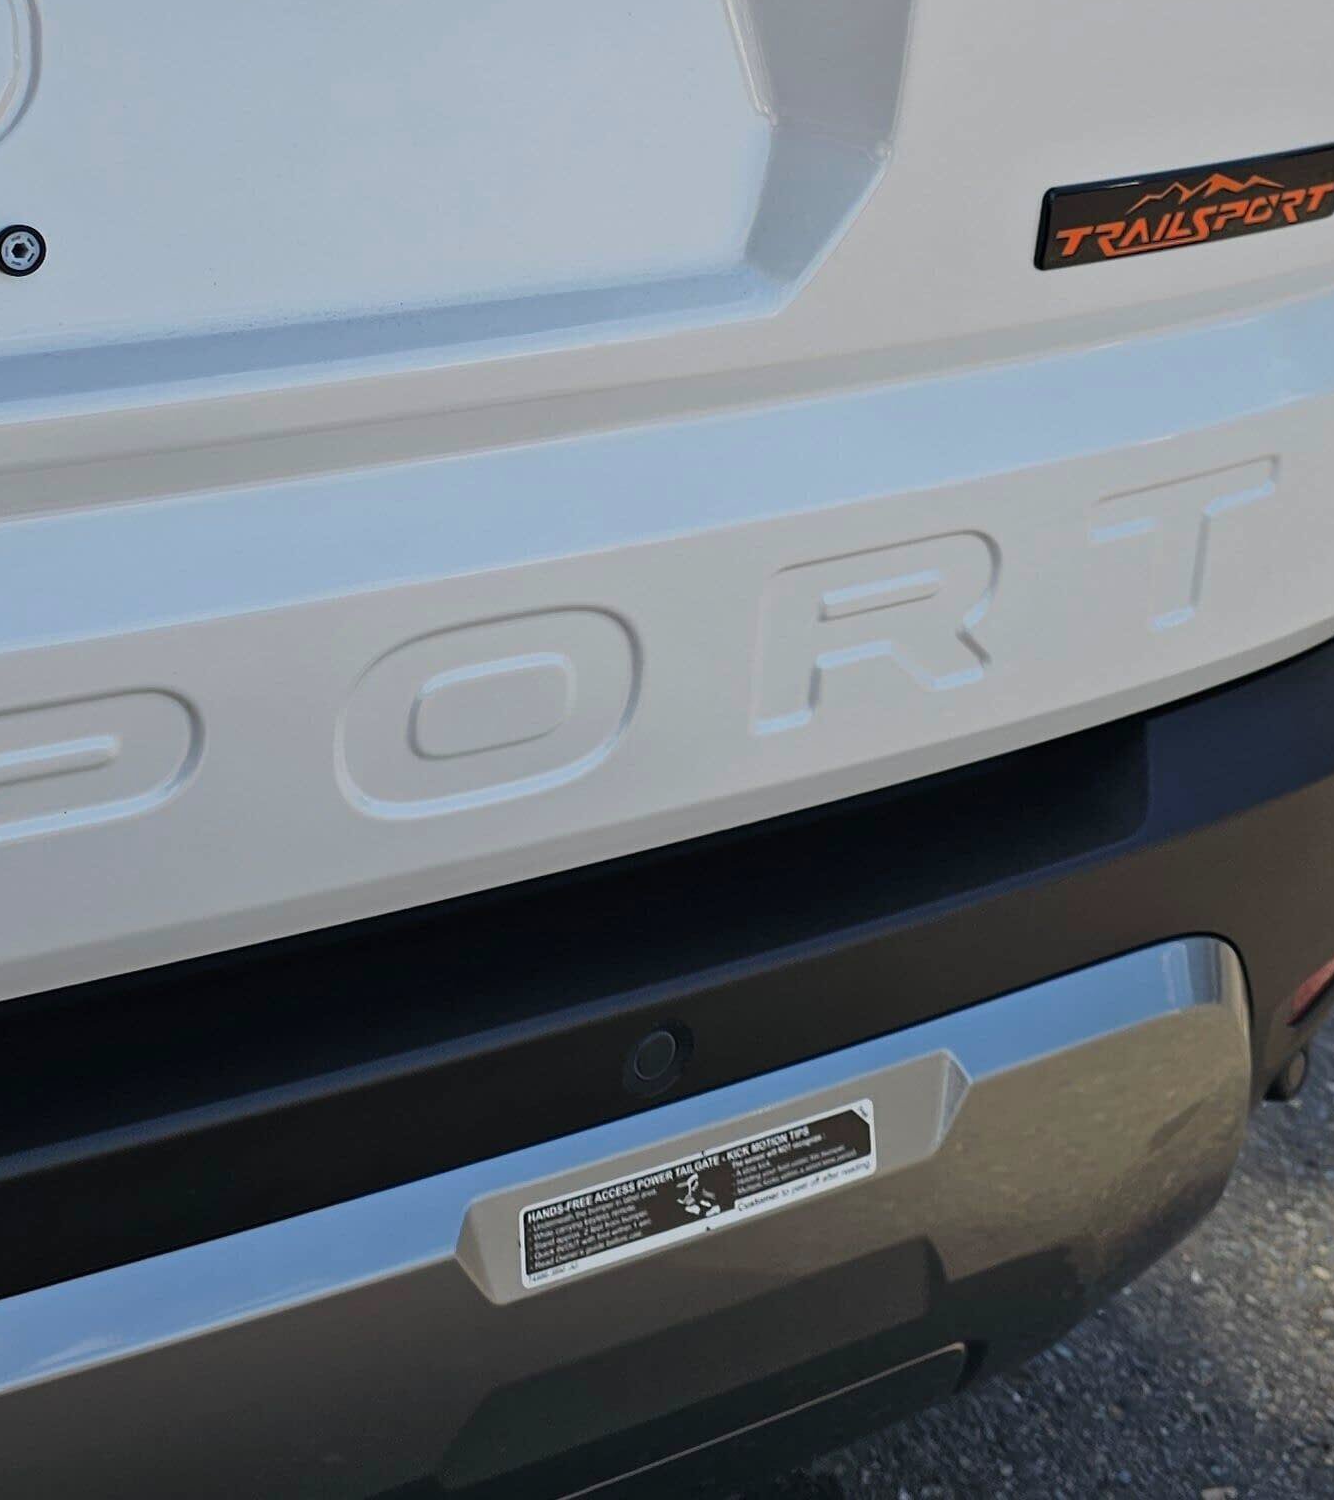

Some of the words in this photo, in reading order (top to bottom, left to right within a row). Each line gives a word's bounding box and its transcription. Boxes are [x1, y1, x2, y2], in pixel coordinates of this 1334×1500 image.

[527, 1194, 594, 1223] HANDS-FREE
[595, 1182, 636, 1203] ACCESS
[637, 1171, 674, 1190] POWER
[727, 1146, 750, 1161] KICK
[750, 1132, 789, 1153] MOTION
[789, 1125, 810, 1141] TIPS
